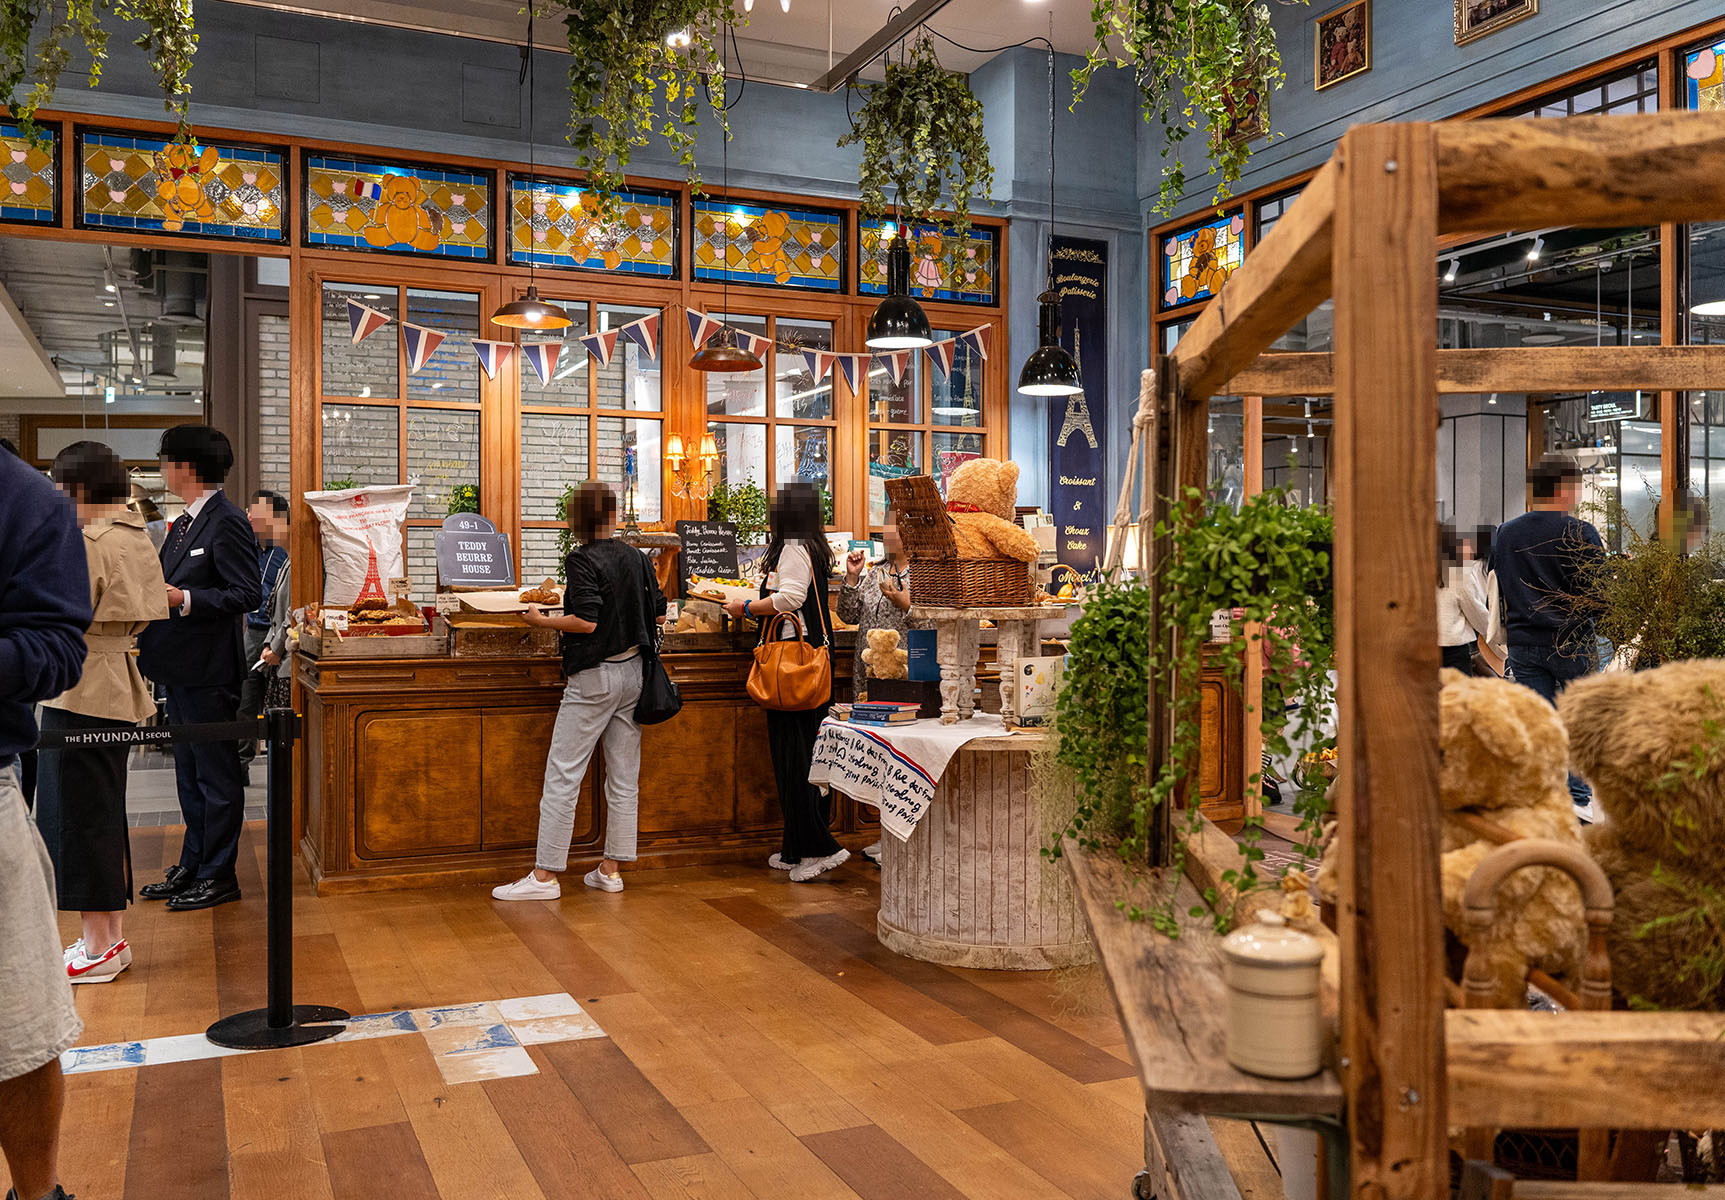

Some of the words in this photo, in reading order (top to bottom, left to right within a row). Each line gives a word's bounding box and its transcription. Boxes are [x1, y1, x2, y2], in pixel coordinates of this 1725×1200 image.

[1055, 272, 1099, 288] Boulangerie
[1058, 285, 1097, 300] Patisserie
[1059, 475, 1096, 487] Croissant
[1073, 500, 1082, 511] &
[459, 521, 478, 530] 49-1
[1064, 525, 1090, 536] Choux
[458, 541, 487, 551] TEDDY
[1066, 540, 1088, 551] Cake
[456, 552, 493, 562] BEURRE
[461, 564, 491, 574] HOUSE
[65, 735, 81, 743] THE
[83, 731, 144, 743] HYUNDAI
[146, 731, 172, 739] SEOUL
